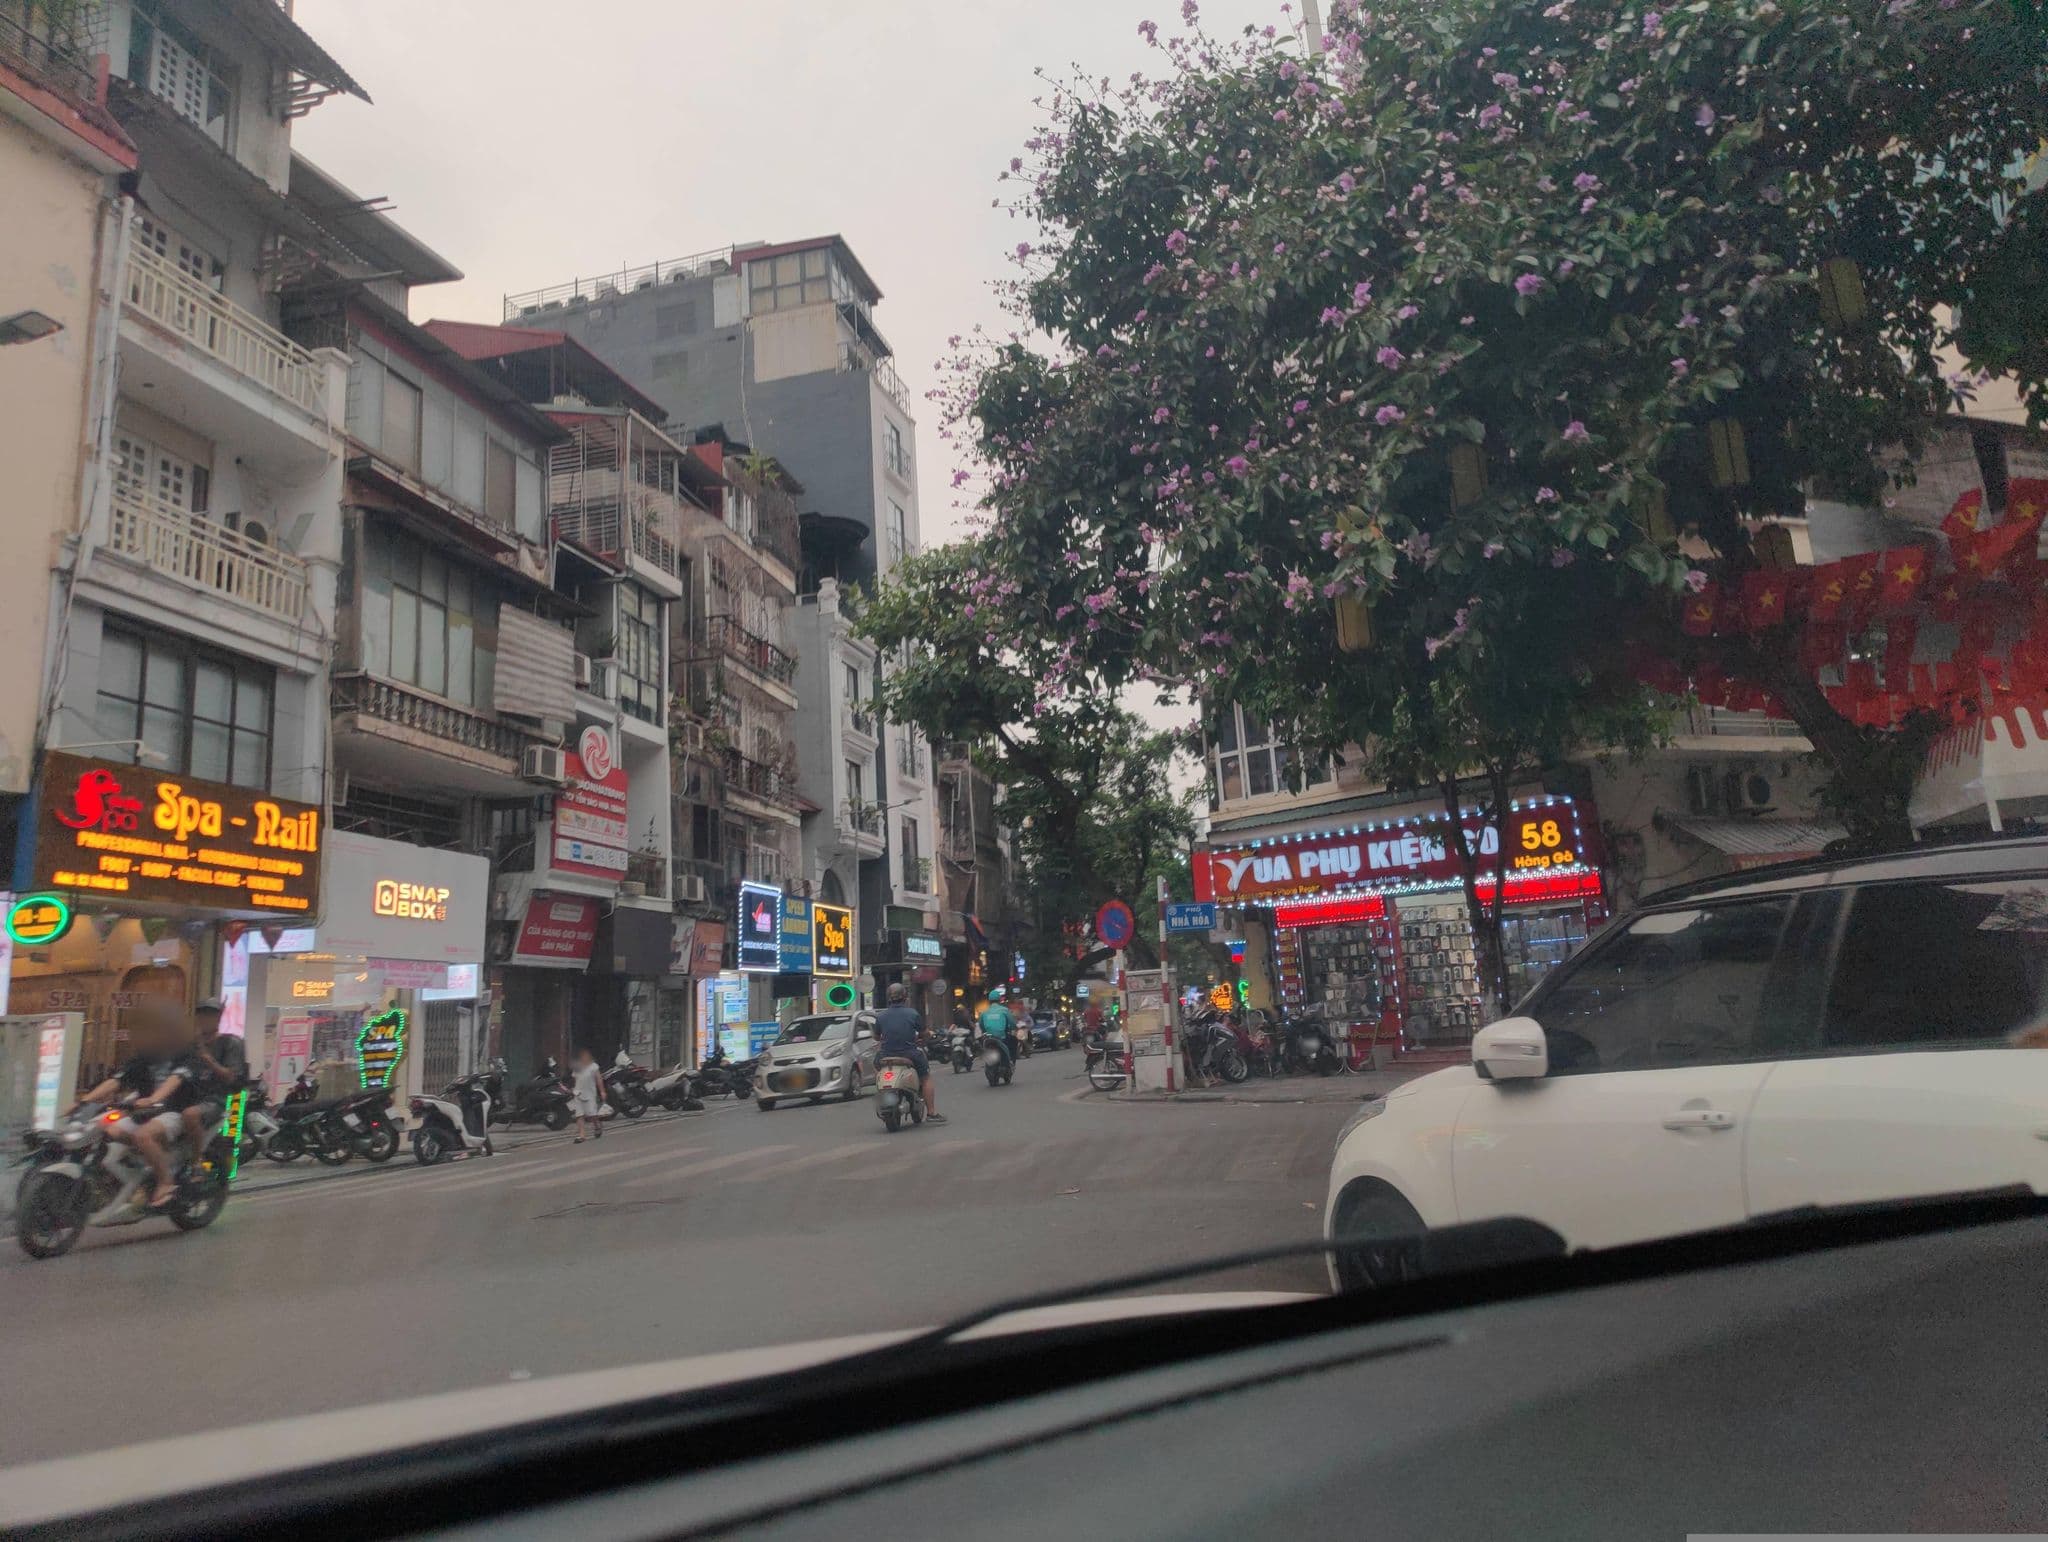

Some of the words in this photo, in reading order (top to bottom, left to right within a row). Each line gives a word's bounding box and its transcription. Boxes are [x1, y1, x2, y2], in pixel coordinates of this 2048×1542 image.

[154, 782, 222, 841] Spa
[253, 800, 318, 852] Nail
[1521, 820, 1562, 850] 58
[1299, 845, 1361, 878] PHỤ
[1367, 830, 1446, 869] KIỆN
[1515, 854, 1550, 869] Hàng
[1552, 850, 1574, 865] Gà
[398, 883, 450, 903] SNAP
[397, 900, 436, 919] BOX
[823, 922, 845, 953] Spa
[48, 990, 88, 1008] SPA
[367, 1025, 396, 1040] SPA
